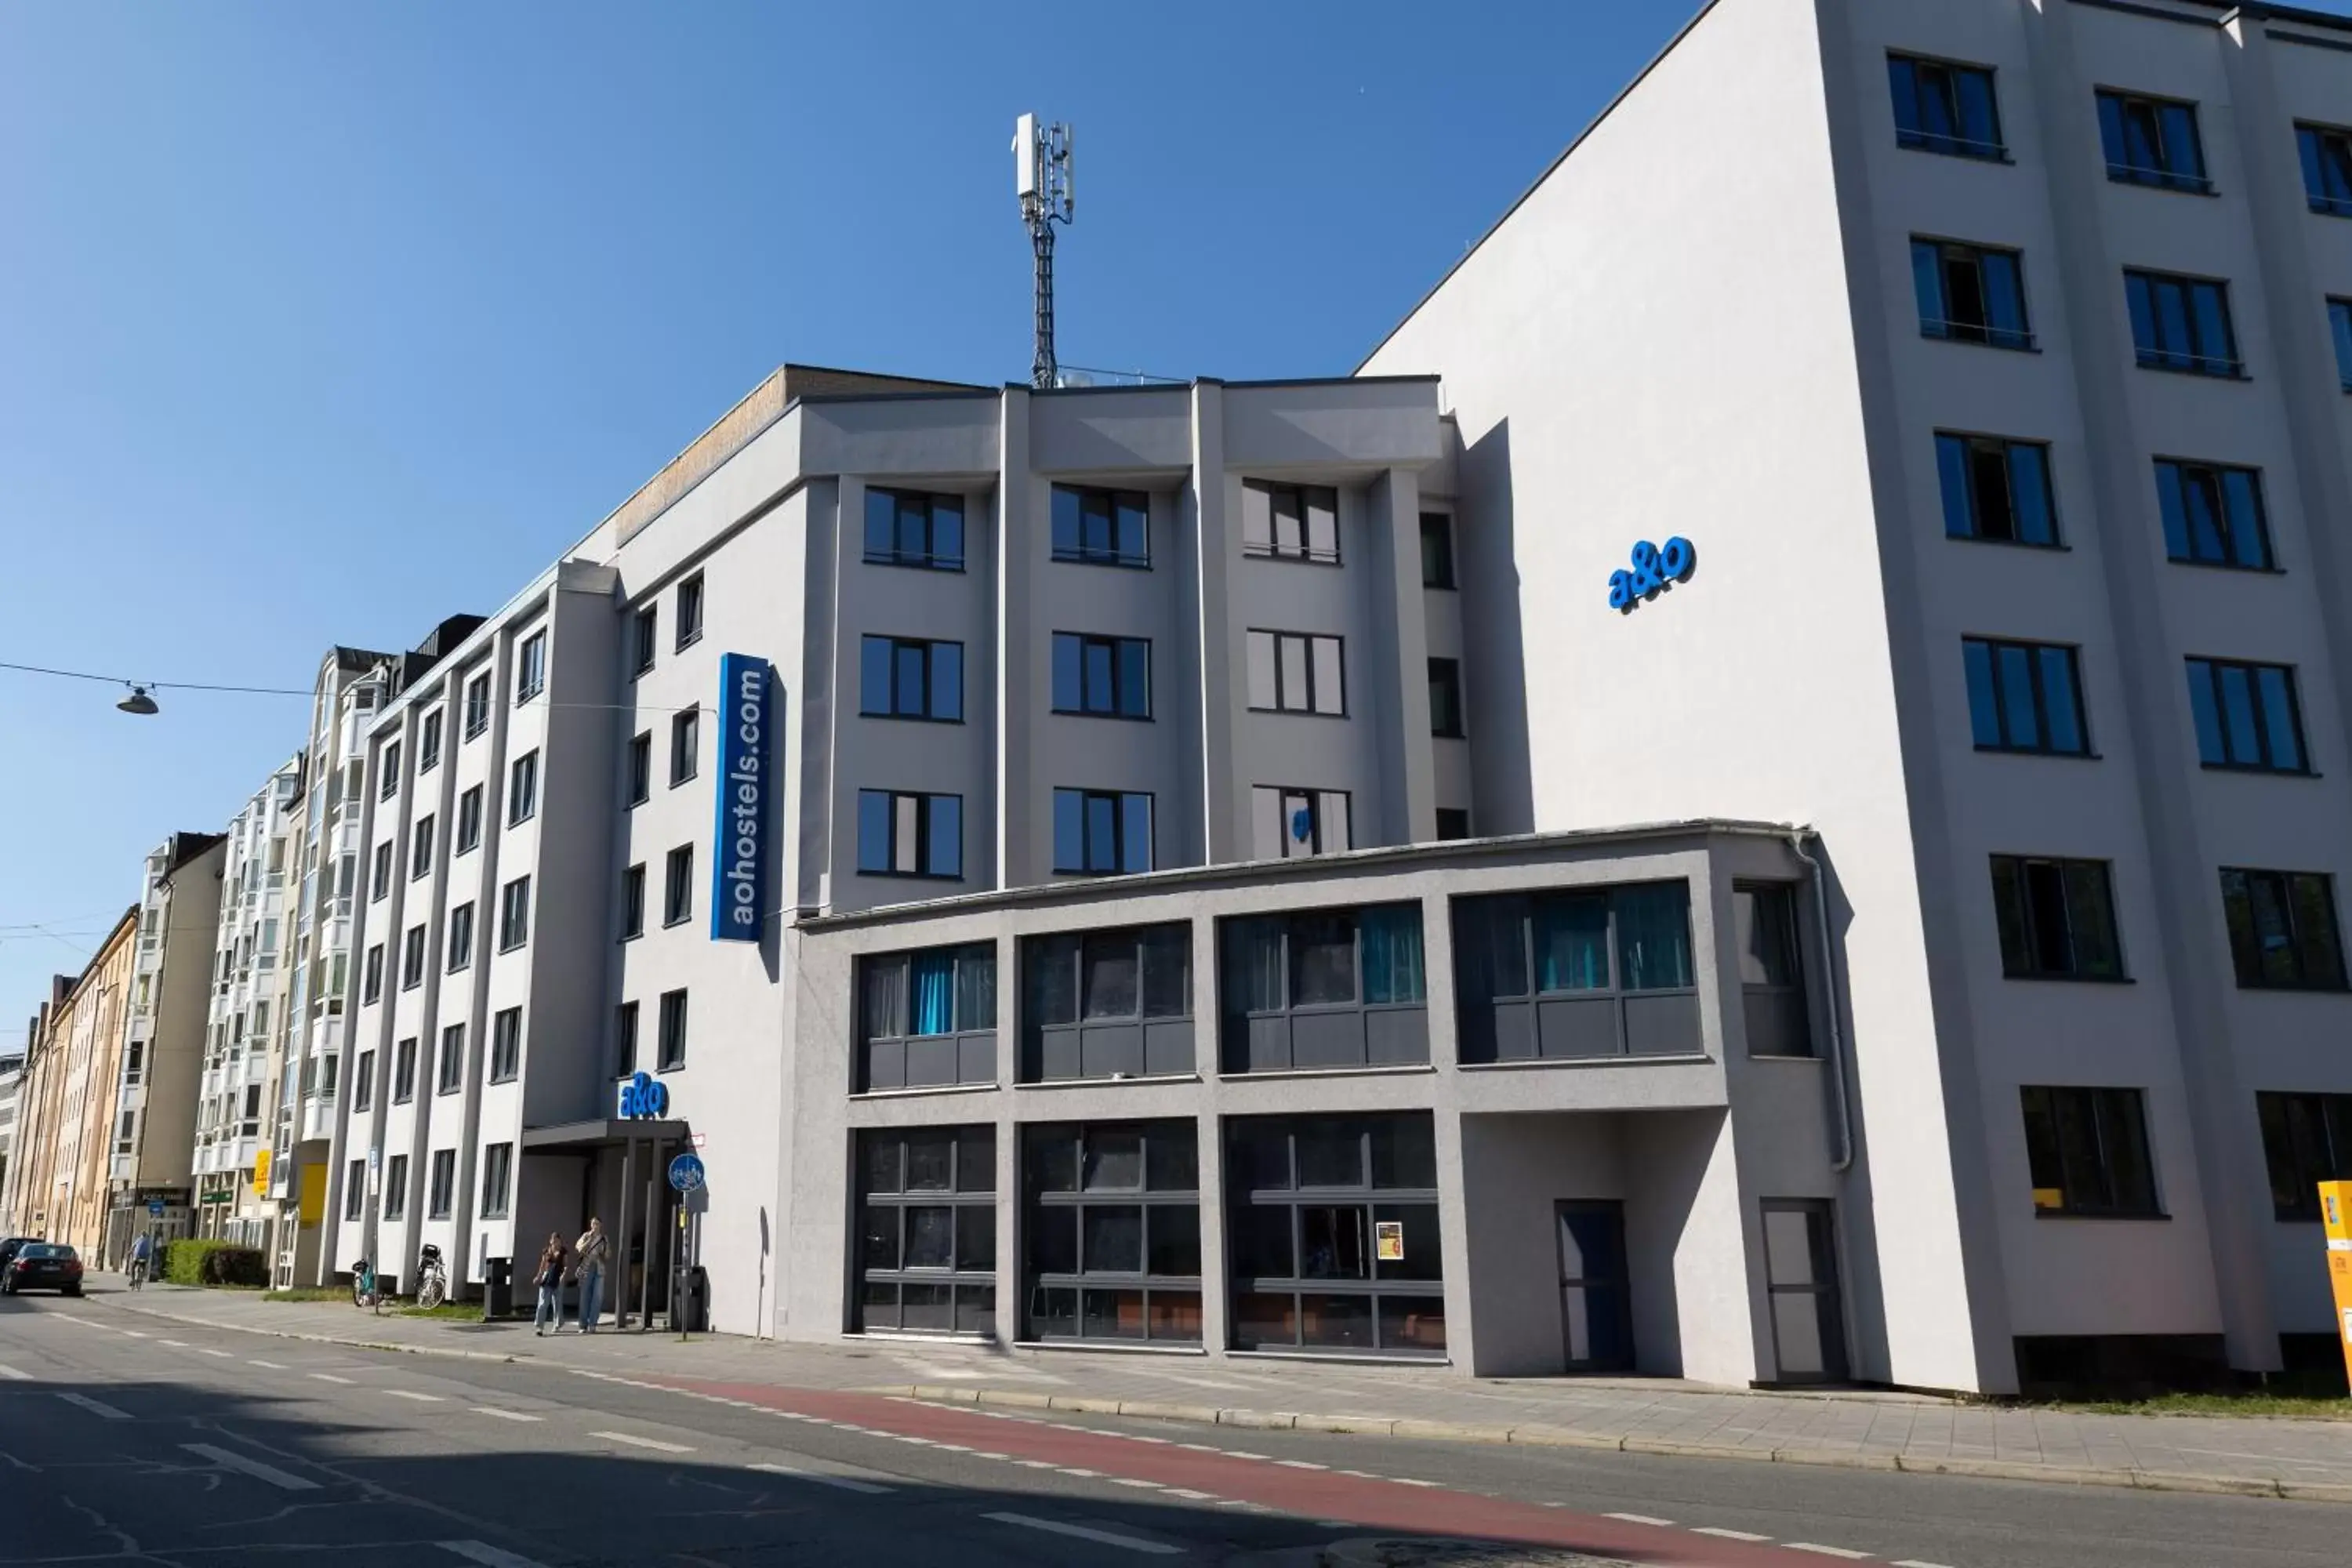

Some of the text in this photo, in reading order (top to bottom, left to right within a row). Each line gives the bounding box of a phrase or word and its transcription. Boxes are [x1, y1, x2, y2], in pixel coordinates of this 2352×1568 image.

[1608, 536, 1694, 612] a&o
[727, 670, 761, 926] aohostels.com
[621, 1072, 669, 1118] a&o
